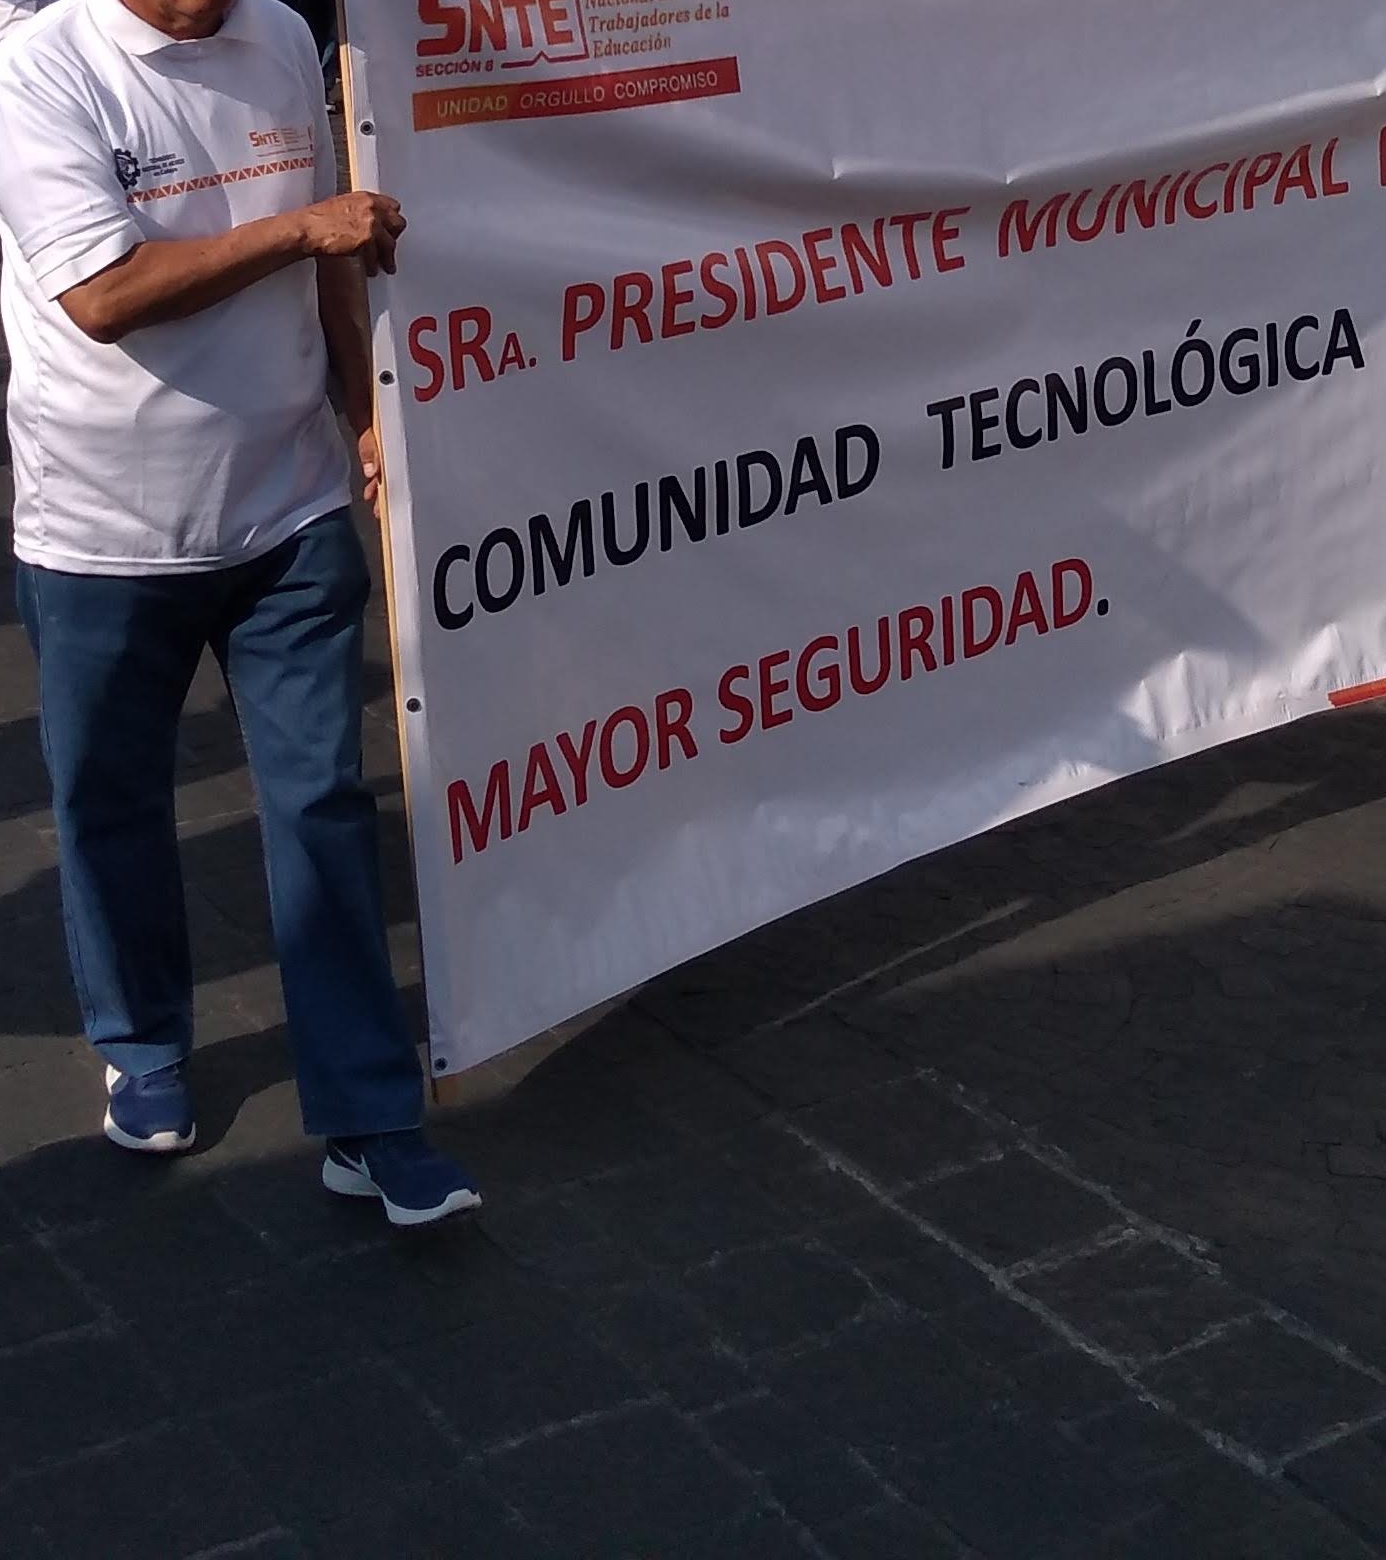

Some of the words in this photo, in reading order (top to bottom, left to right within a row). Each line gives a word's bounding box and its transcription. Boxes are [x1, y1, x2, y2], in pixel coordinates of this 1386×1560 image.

[588, 10, 691, 34] Trabajadores
[694, 2, 712, 21] de
[715, 1, 730, 19] la
[416, 59, 485, 78] SECCIÓN
[593, 32, 672, 59] Educación
[436, 94, 509, 118] UNIDAD
[519, 84, 605, 108] ORGULLO
[614, 70, 718, 100] COMPROMISO
[562, 206, 972, 362] PRESIDENTE
[997, 137, 1350, 259] MUNICIPAL
[432, 423, 881, 632] COMUNIDAD
[926, 307, 1366, 470] TECNOLÓGICA
[445, 686, 700, 866] MAYOR
[716, 555, 1111, 745] SEGURIDAD.
